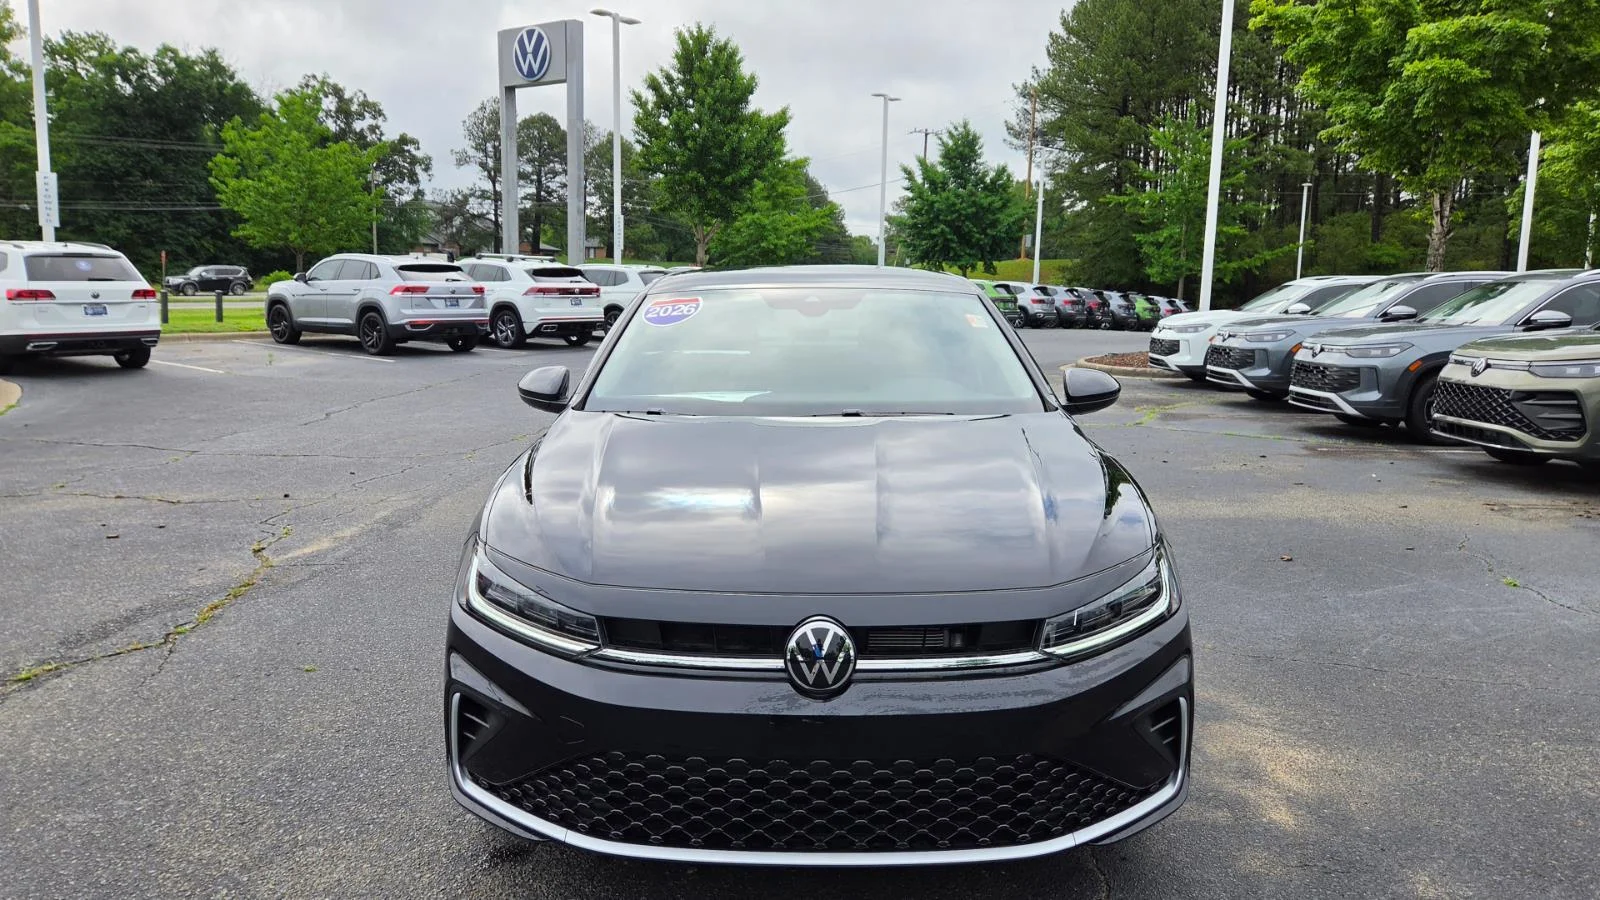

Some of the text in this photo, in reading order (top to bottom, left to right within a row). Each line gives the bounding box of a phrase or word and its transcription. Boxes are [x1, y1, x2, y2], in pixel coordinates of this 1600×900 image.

[514, 27, 549, 78] VW
[645, 303, 697, 318] 2026
[789, 620, 850, 686] VW
